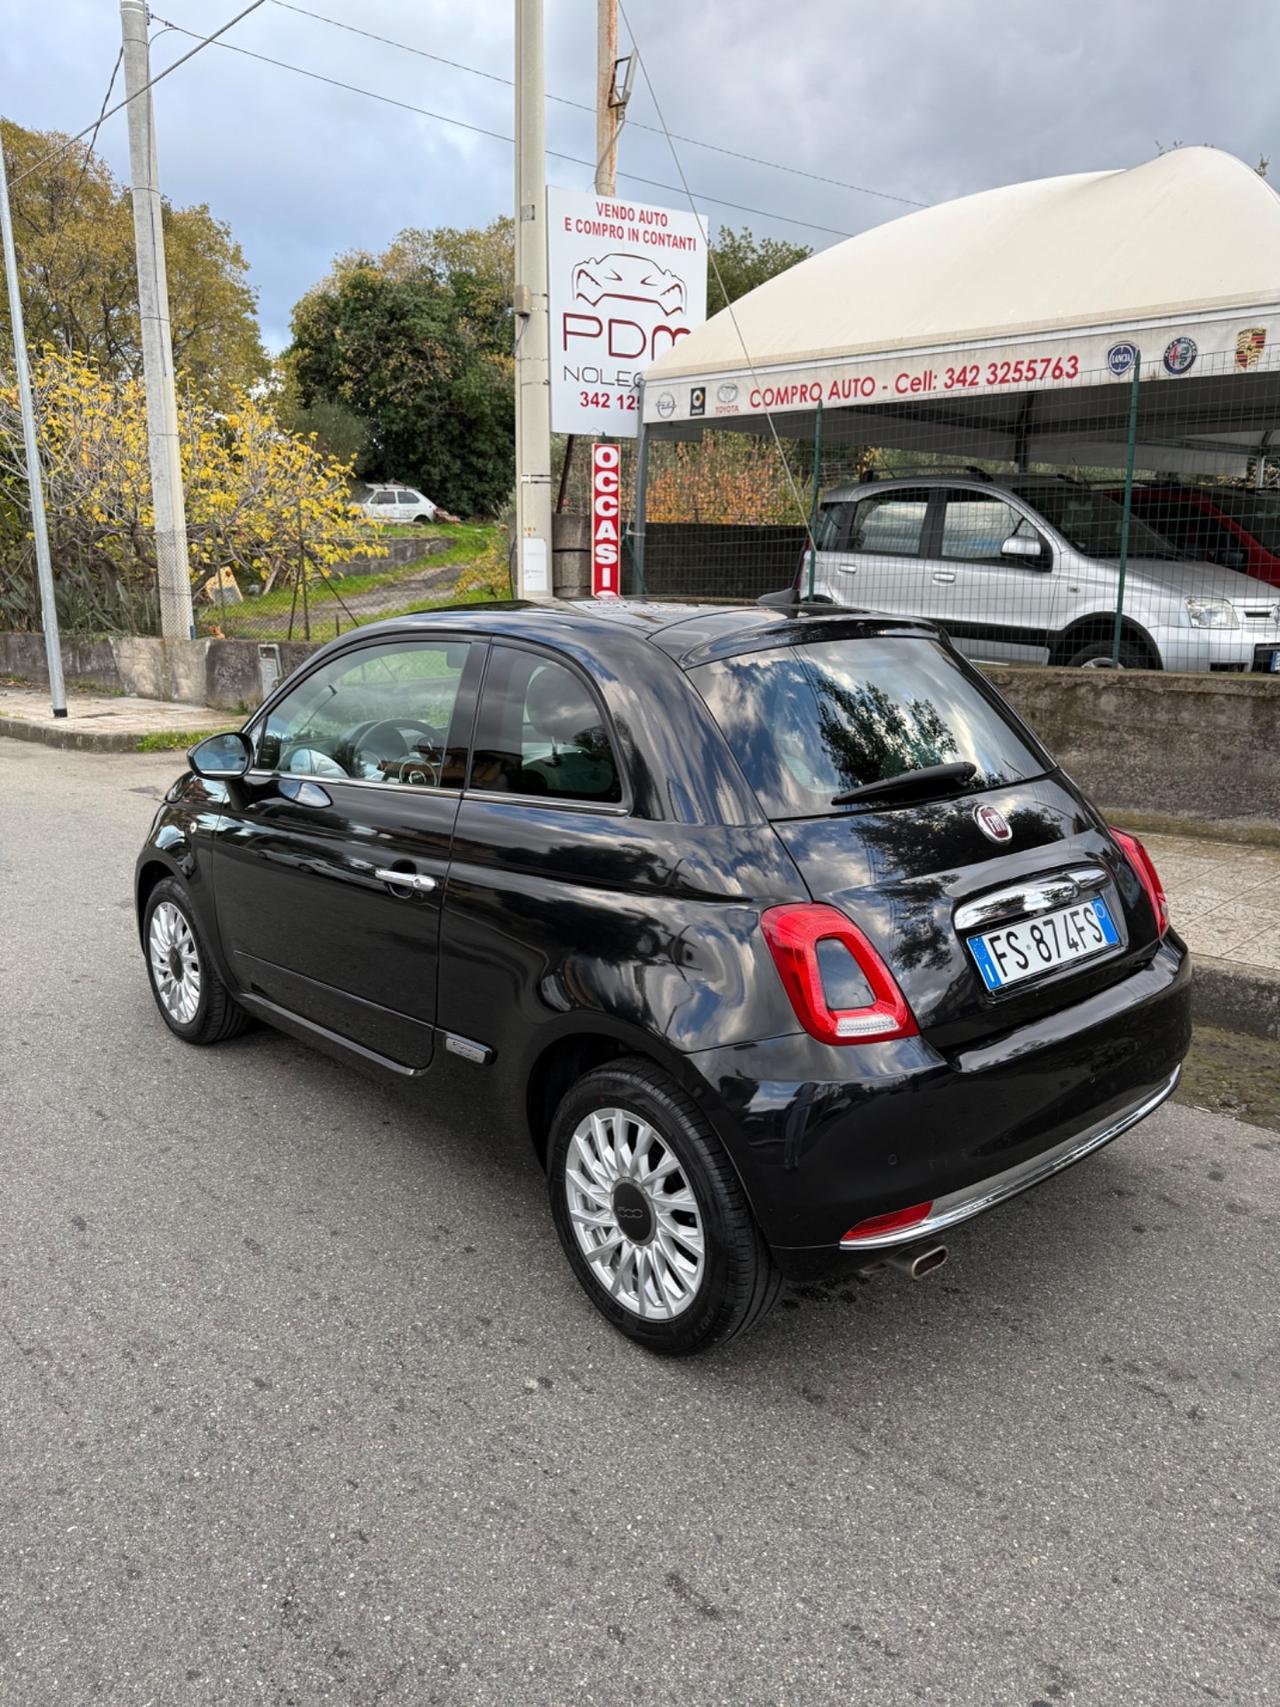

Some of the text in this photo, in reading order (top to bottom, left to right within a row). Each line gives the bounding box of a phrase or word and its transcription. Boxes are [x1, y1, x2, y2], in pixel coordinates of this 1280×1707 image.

[596, 201, 668, 227] VENDO AUTO
[564, 217, 697, 251] E COMPRO IN CONTANTI
[750, 382, 822, 408] COMPRO
[828, 376, 875, 400] AUTO
[895, 370, 937, 394] Cell:
[944, 364, 980, 389] 342
[986, 355, 1079, 385] 3255763
[580, 391, 640, 411] 342 12
[988, 907, 1104, 978] FS 874FS
